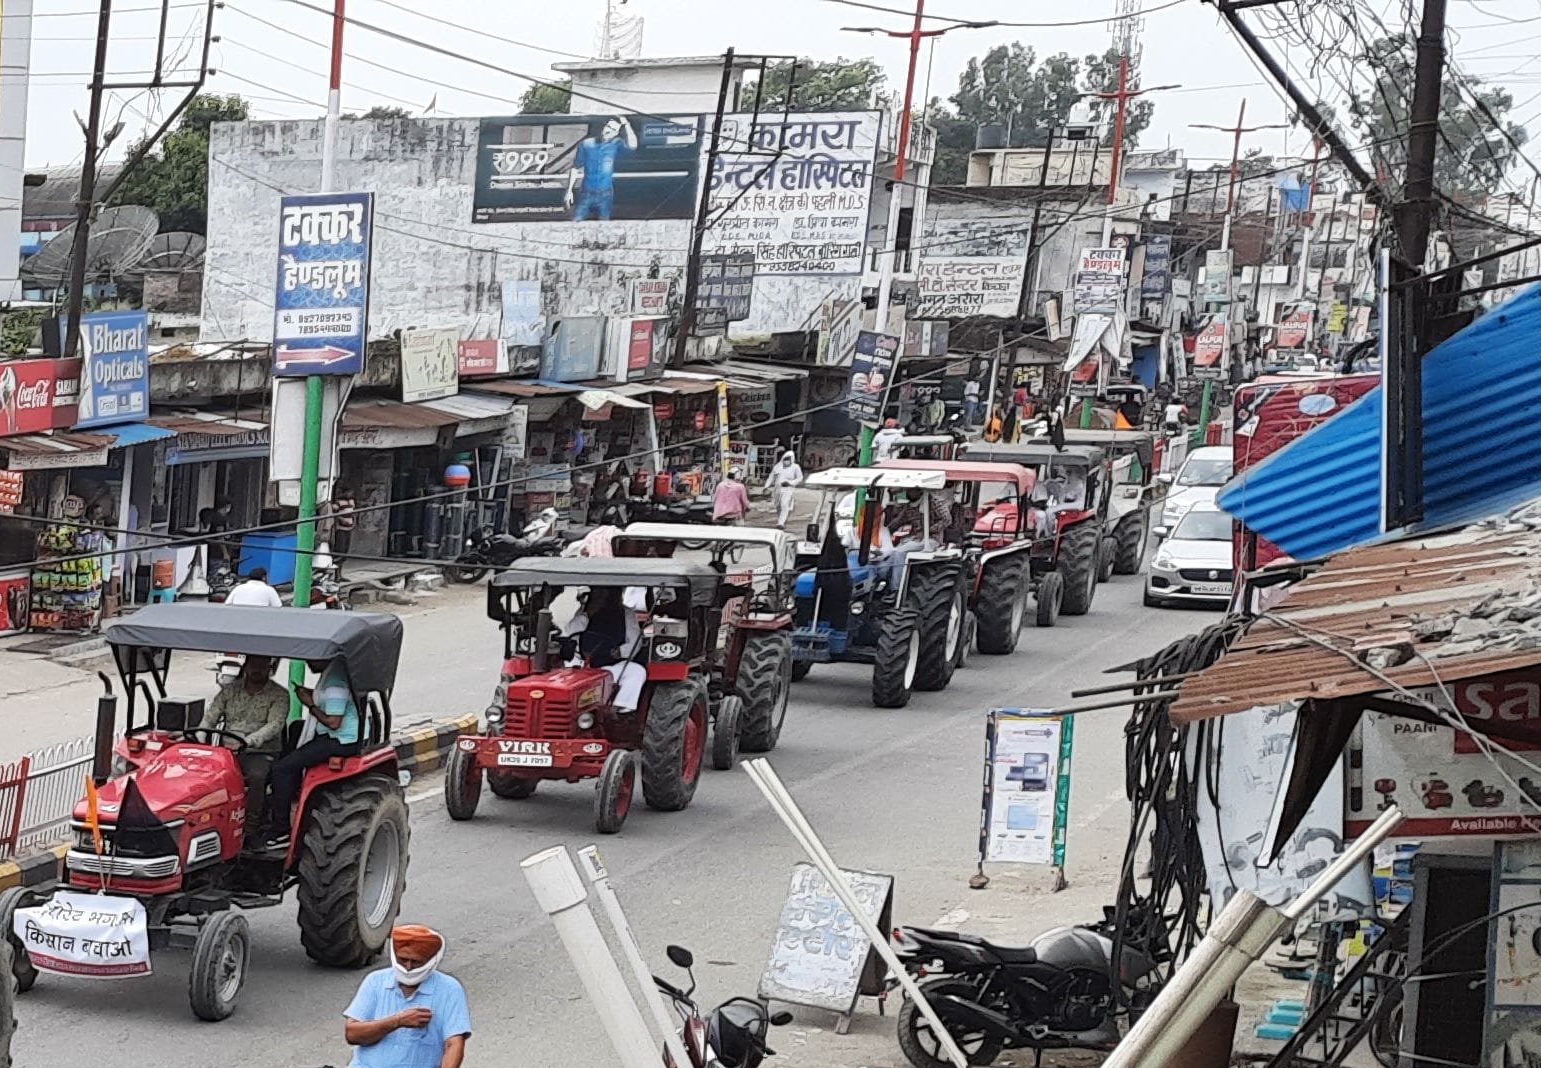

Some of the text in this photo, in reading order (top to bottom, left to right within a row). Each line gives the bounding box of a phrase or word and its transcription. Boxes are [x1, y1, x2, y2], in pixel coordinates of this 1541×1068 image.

[283, 202, 364, 248] टक्कर
[280, 253, 363, 300] हैण्डलूम
[92, 321, 144, 355] Bharat
[93, 354, 144, 385] Opticals
[497, 740, 551, 754] VIRK
[1451, 818, 1518, 831] Available
[24, 919, 77, 954] किसान
